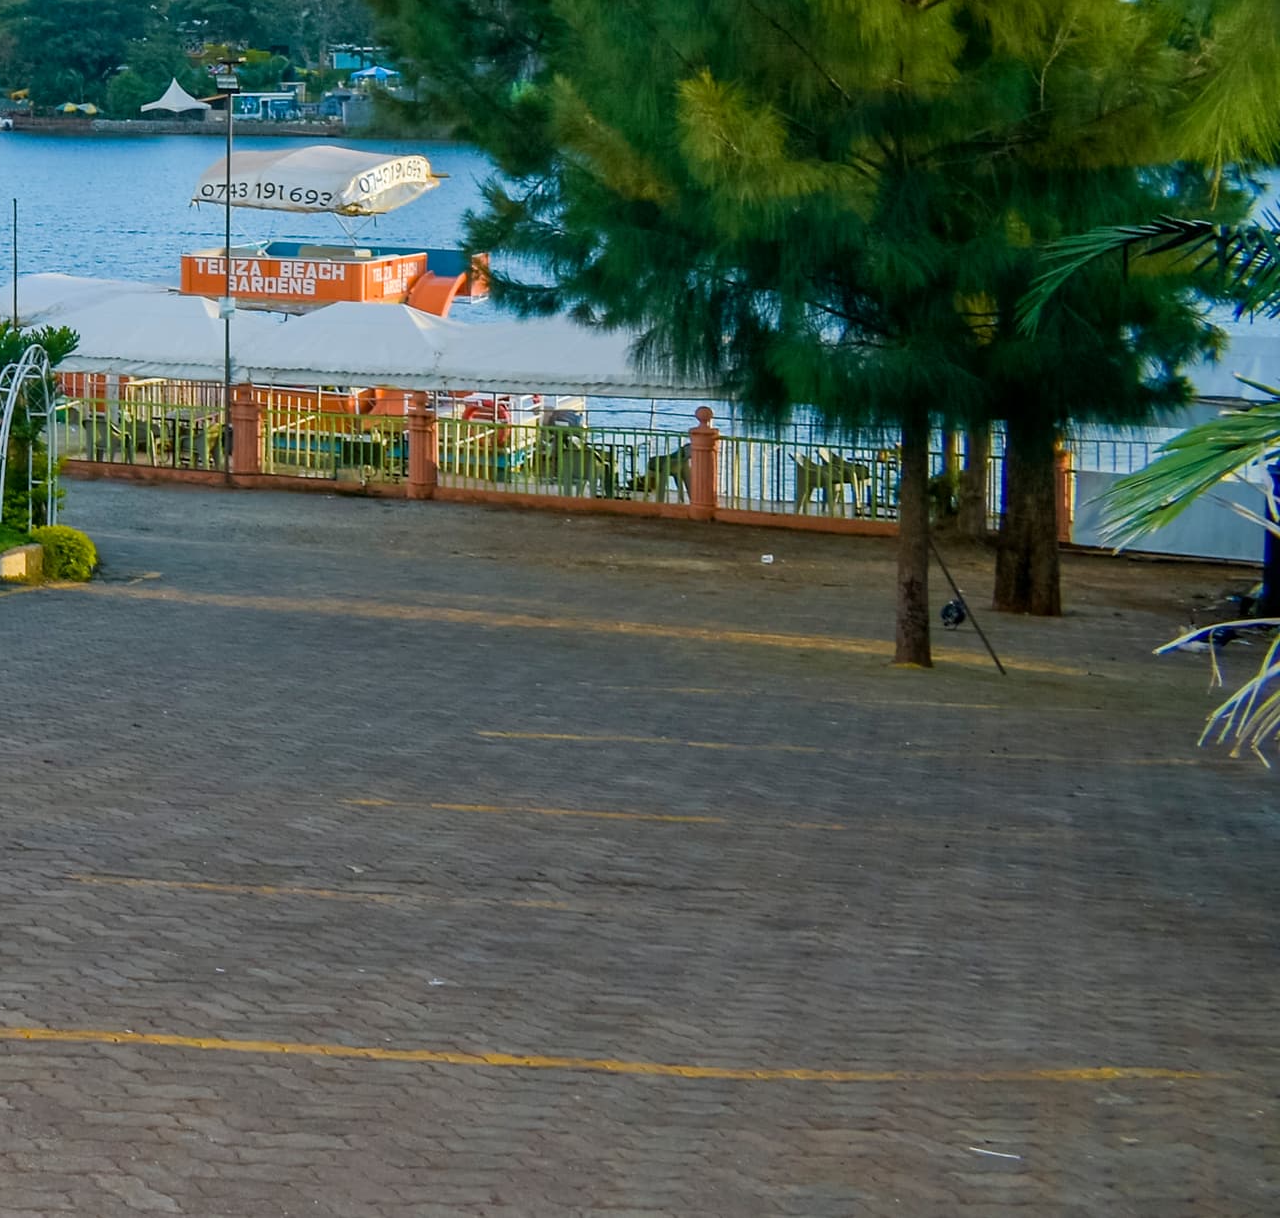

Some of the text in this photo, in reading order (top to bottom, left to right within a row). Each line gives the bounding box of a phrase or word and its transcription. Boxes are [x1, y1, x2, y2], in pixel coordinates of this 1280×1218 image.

[201, 182, 333, 206] 0743 191 693
[195, 258, 345, 280] TELIZA BEACH
